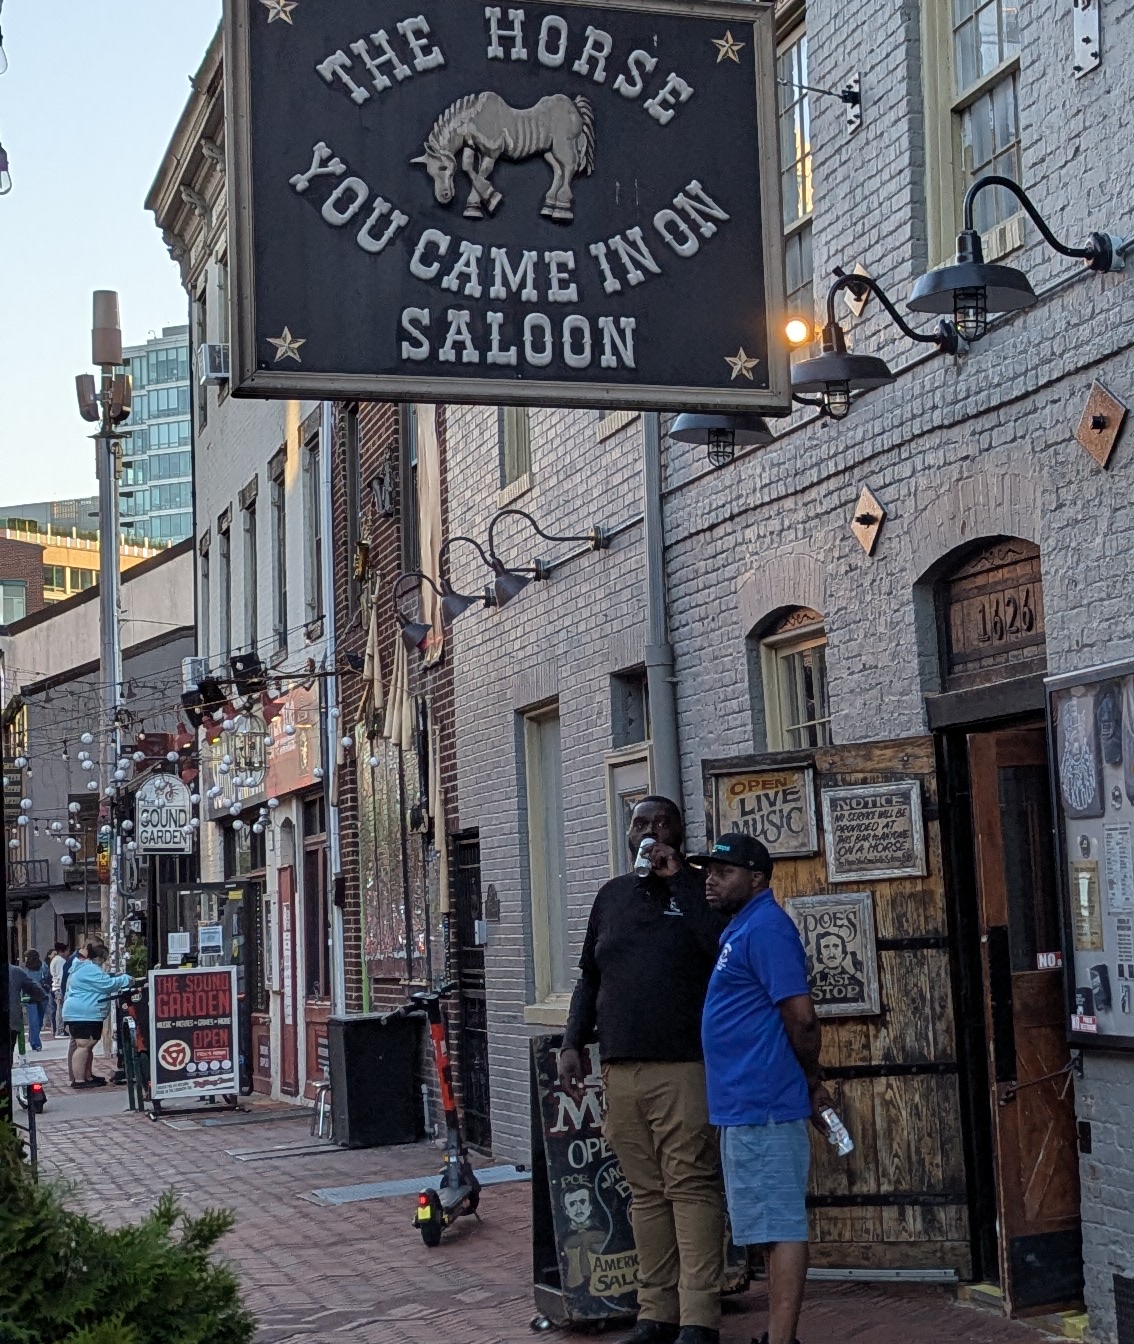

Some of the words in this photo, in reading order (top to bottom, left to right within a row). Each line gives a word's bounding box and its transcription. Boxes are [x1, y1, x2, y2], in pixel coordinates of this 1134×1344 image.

[315, 14, 446, 105] THE
[485, 6, 695, 126] HORSE
[289, 141, 409, 254] YOU
[410, 228, 578, 303] CAME
[589, 225, 662, 294] IN
[653, 178, 731, 258] ON
[401, 307, 637, 368] SALOON
[978, 587, 1035, 643] 1626
[729, 776, 788, 796] OPEN
[739, 785, 801, 818] LIVE
[837, 796, 903, 811] NOTICE
[834, 813, 845, 824] NO
[845, 810, 877, 822] SERVICE
[895, 808, 907, 818] BE
[731, 807, 804, 845] MUSIC
[835, 821, 879, 835] PROVIDED
[882, 820, 896, 831] AT
[140, 829, 187, 845] GARDEN
[836, 834, 854, 846] THIS
[854, 833, 871, 844] BAR
[837, 844, 855, 857] ON
[855, 844, 865, 855] A
[156, 976, 179, 993] THE
[186, 973, 229, 992] SOUND
[816, 975, 850, 986] LAST
[811, 985, 860, 1001] STOP
[157, 990, 230, 1018] GARDEN
[193, 1028, 229, 1047] OPEN
[568, 1137, 613, 1168] OPE
[561, 1174, 593, 1188] POE
